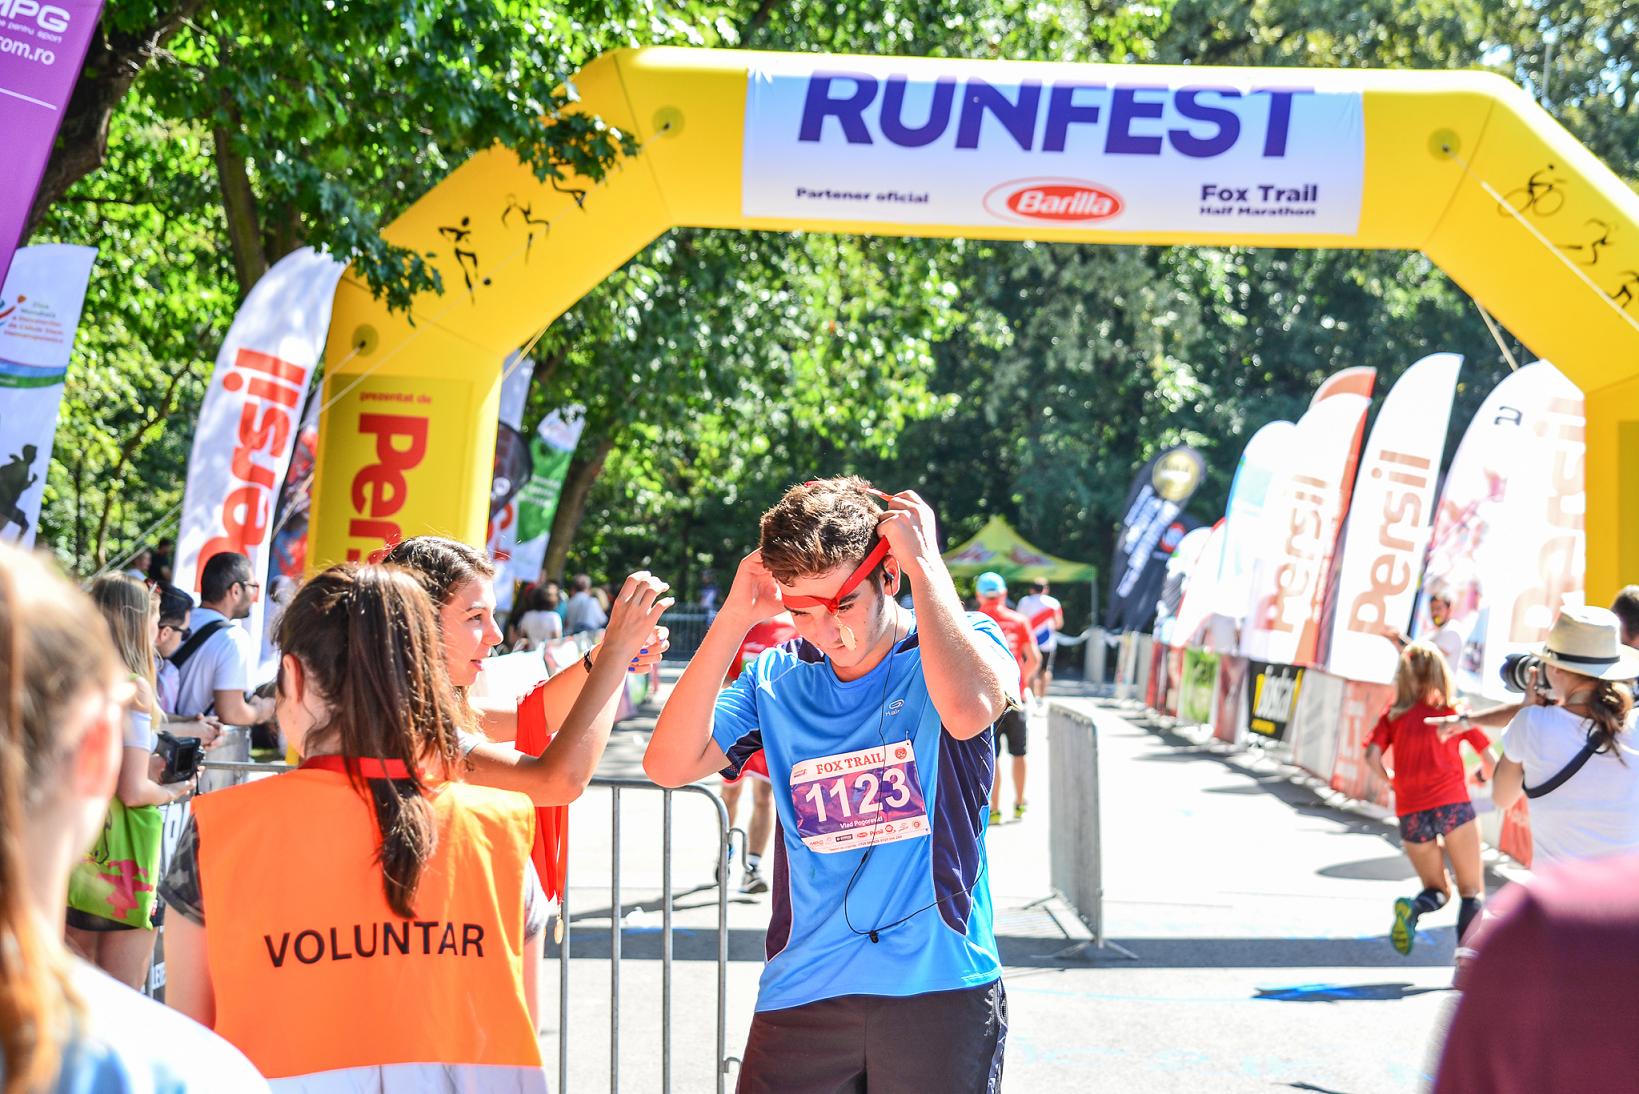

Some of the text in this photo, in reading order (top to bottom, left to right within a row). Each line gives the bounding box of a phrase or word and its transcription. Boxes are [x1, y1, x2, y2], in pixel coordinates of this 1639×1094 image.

[798, 69, 1314, 158] RUNFEST
[796, 187, 929, 203] Partener oficial
[1016, 189, 1112, 216] Barilla
[1201, 184, 1318, 203] Fox Trail
[1200, 206, 1316, 217] Half Marathon
[360, 391, 432, 404] prezentat de
[1347, 449, 1431, 632] Persil
[816, 760, 843, 774] FOX
[845, 753, 885, 769] TRAIL
[806, 768, 910, 822] 1123
[264, 920, 486, 968] VOLUNTAR
